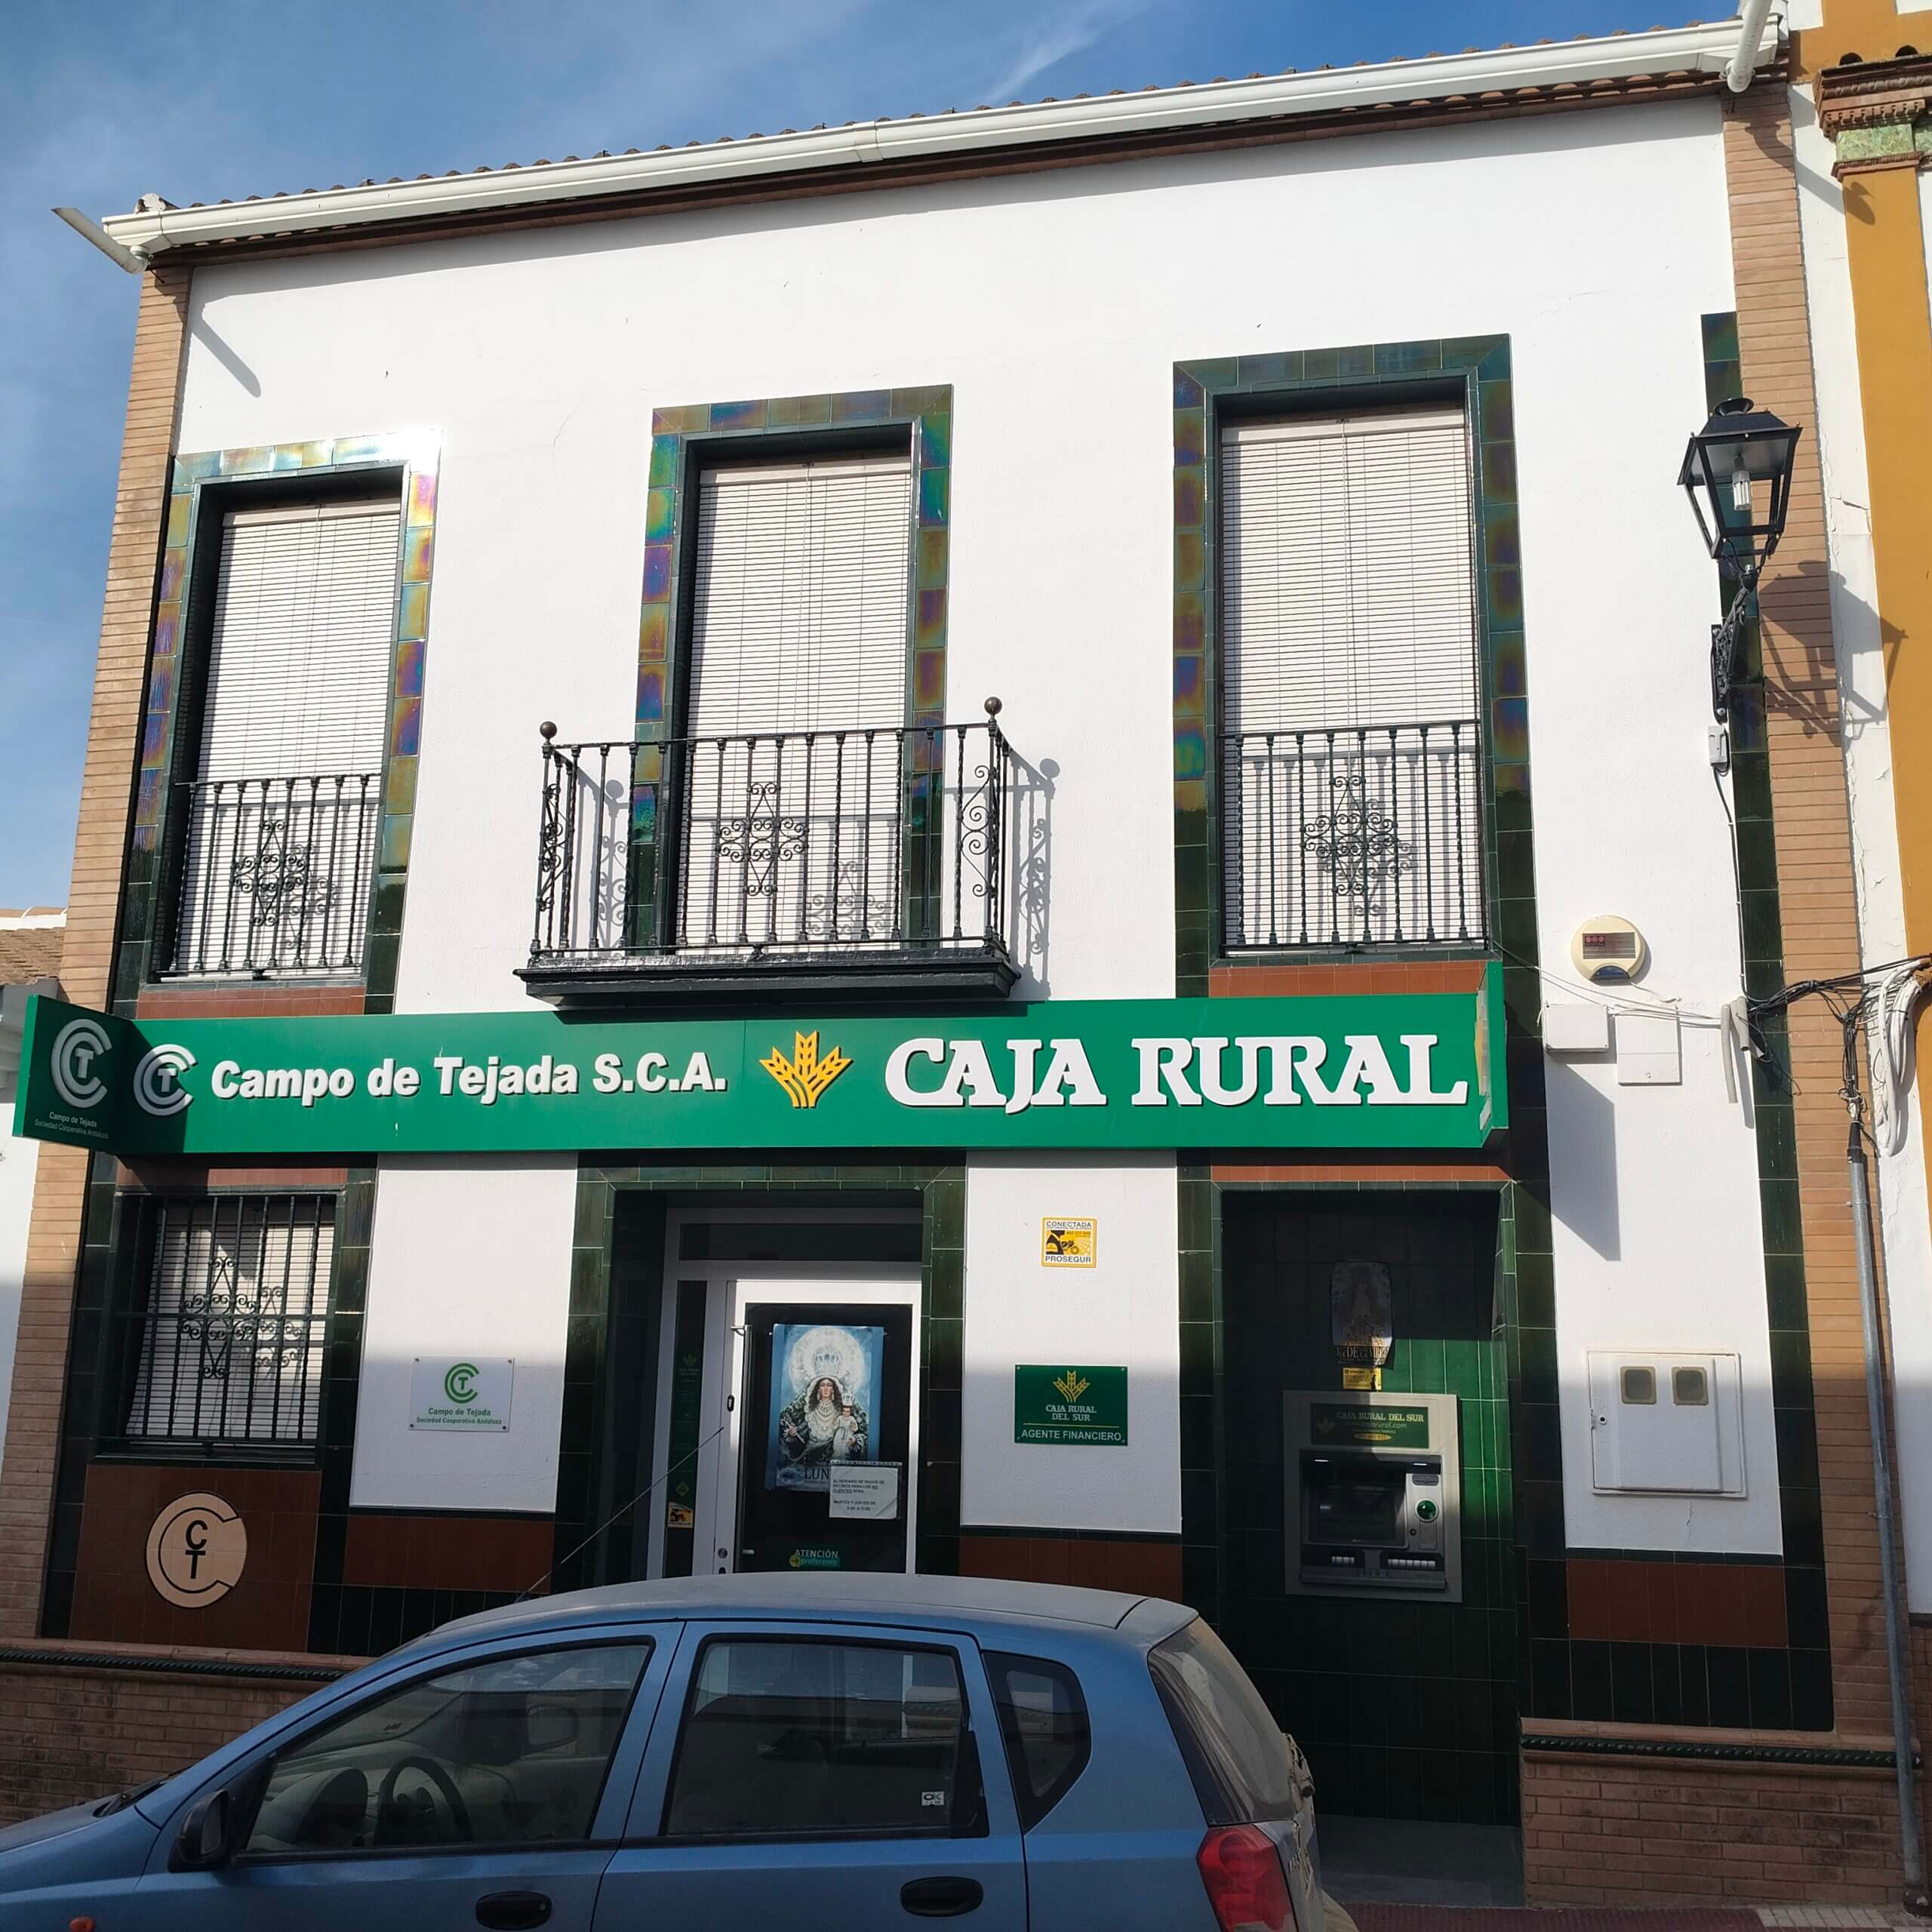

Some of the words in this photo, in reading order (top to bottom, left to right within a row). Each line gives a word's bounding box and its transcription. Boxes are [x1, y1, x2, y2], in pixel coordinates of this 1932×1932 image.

[211, 1060, 355, 1106] Campo
[367, 1058, 420, 1097] de
[434, 1054, 579, 1105] Tejada
[592, 1051, 728, 1093] S.C.A.
[884, 1037, 1108, 1115] CAJA
[1131, 1034, 1469, 1107] RURAL
[49, 1111, 70, 1123] Campo
[70, 1115, 78, 1124] de
[79, 1117, 97, 1128] Tejada
[34, 1118, 57, 1130] Sociedad
[58, 1123, 87, 1136] Cooperativa
[428, 1407, 454, 1417] Campo
[455, 1407, 464, 1416] de
[466, 1408, 491, 1417] Tejada
[1045, 1404, 1067, 1413] CAJA
[1068, 1405, 1097, 1414] RURAL
[1072, 1414, 1091, 1422] SUR
[1358, 1412, 1386, 1420] RURAL
[1388, 1413, 1405, 1421] DEL
[1406, 1414, 1425, 1423] SUR
[1021, 1429, 1060, 1438] AGENTE
[1063, 1430, 1122, 1441] FINANCIERO
[795, 1549, 838, 1558] ATENCIÓN
